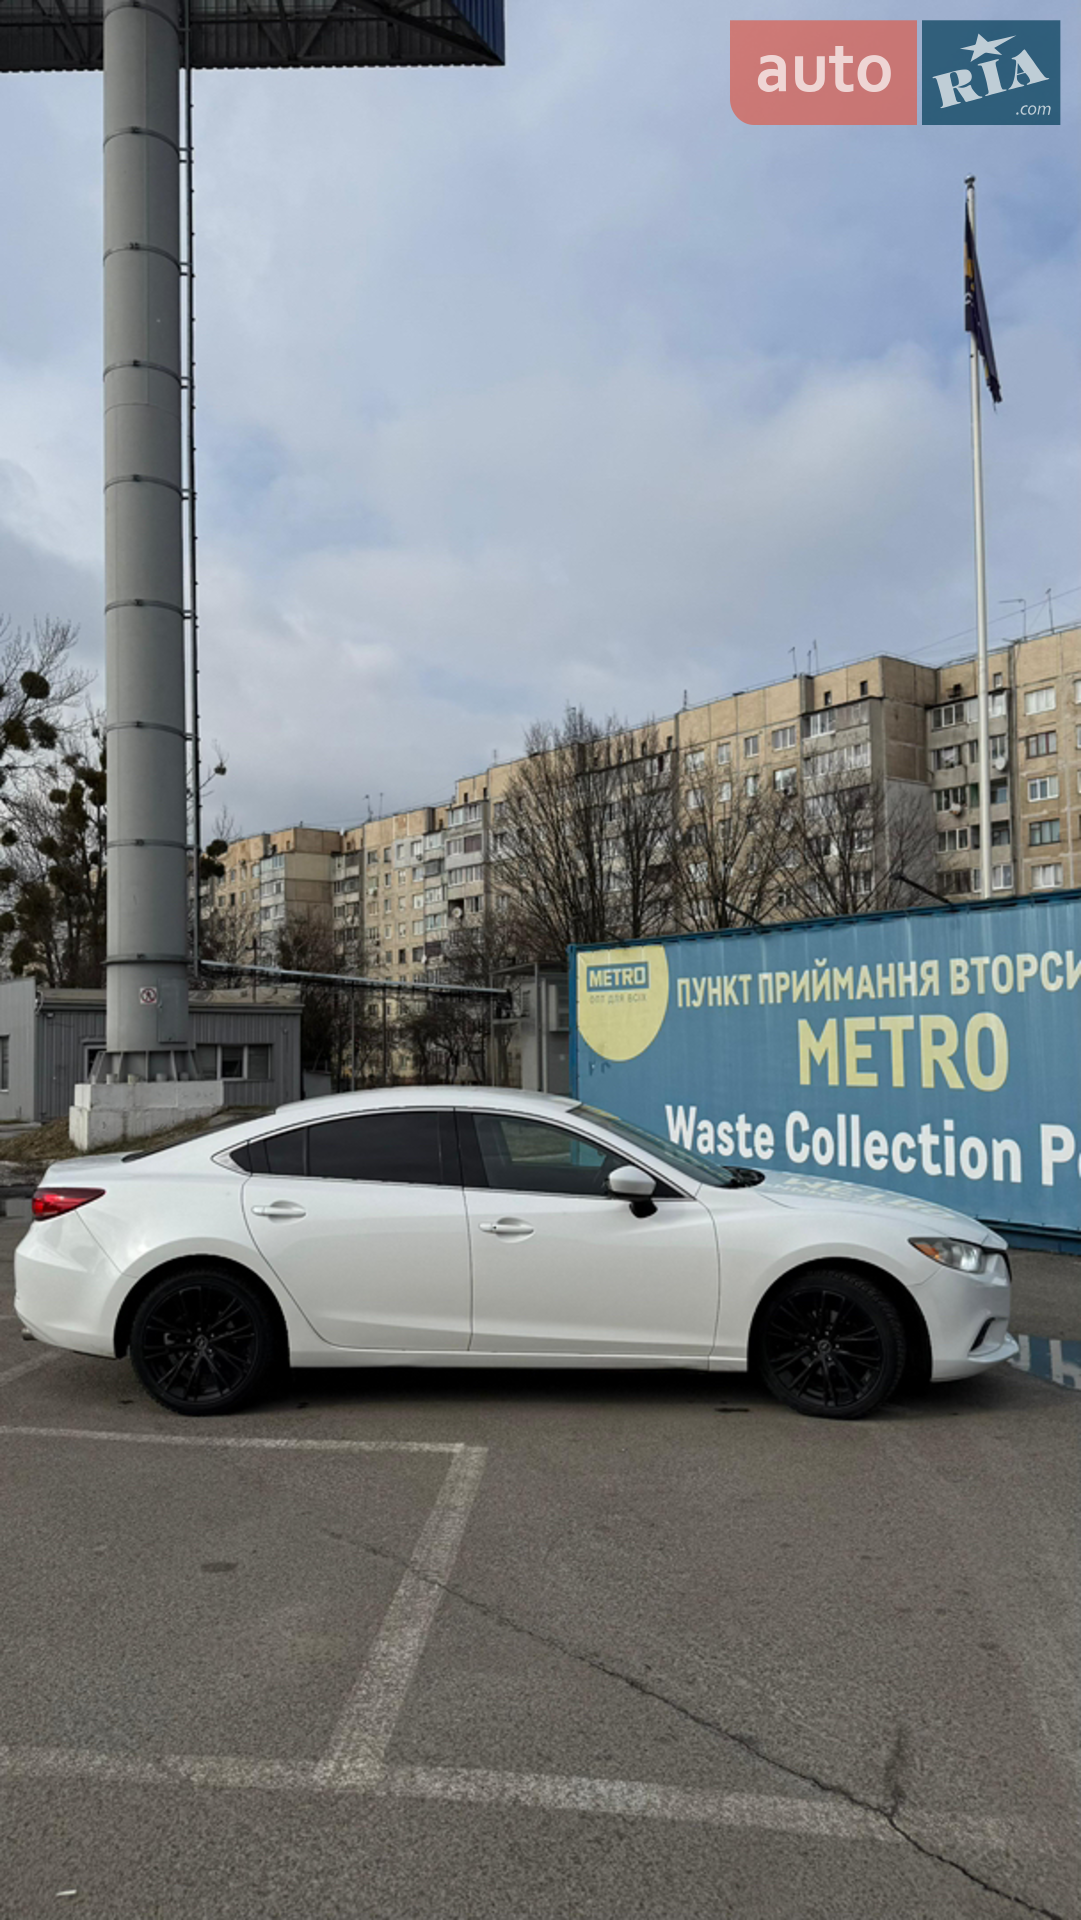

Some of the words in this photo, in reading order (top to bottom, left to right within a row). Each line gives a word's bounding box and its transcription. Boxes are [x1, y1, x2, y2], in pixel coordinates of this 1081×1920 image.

[589, 966, 647, 988] METRO
[677, 974, 752, 1008] ПУНКТ
[758, 957, 940, 1005] ПРИЙМАННЯ
[797, 1012, 1010, 1092] METRO
[664, 1104, 775, 1160] Waste
[785, 1110, 1022, 1184] Collection
[1040, 1123, 1081, 1187] P
